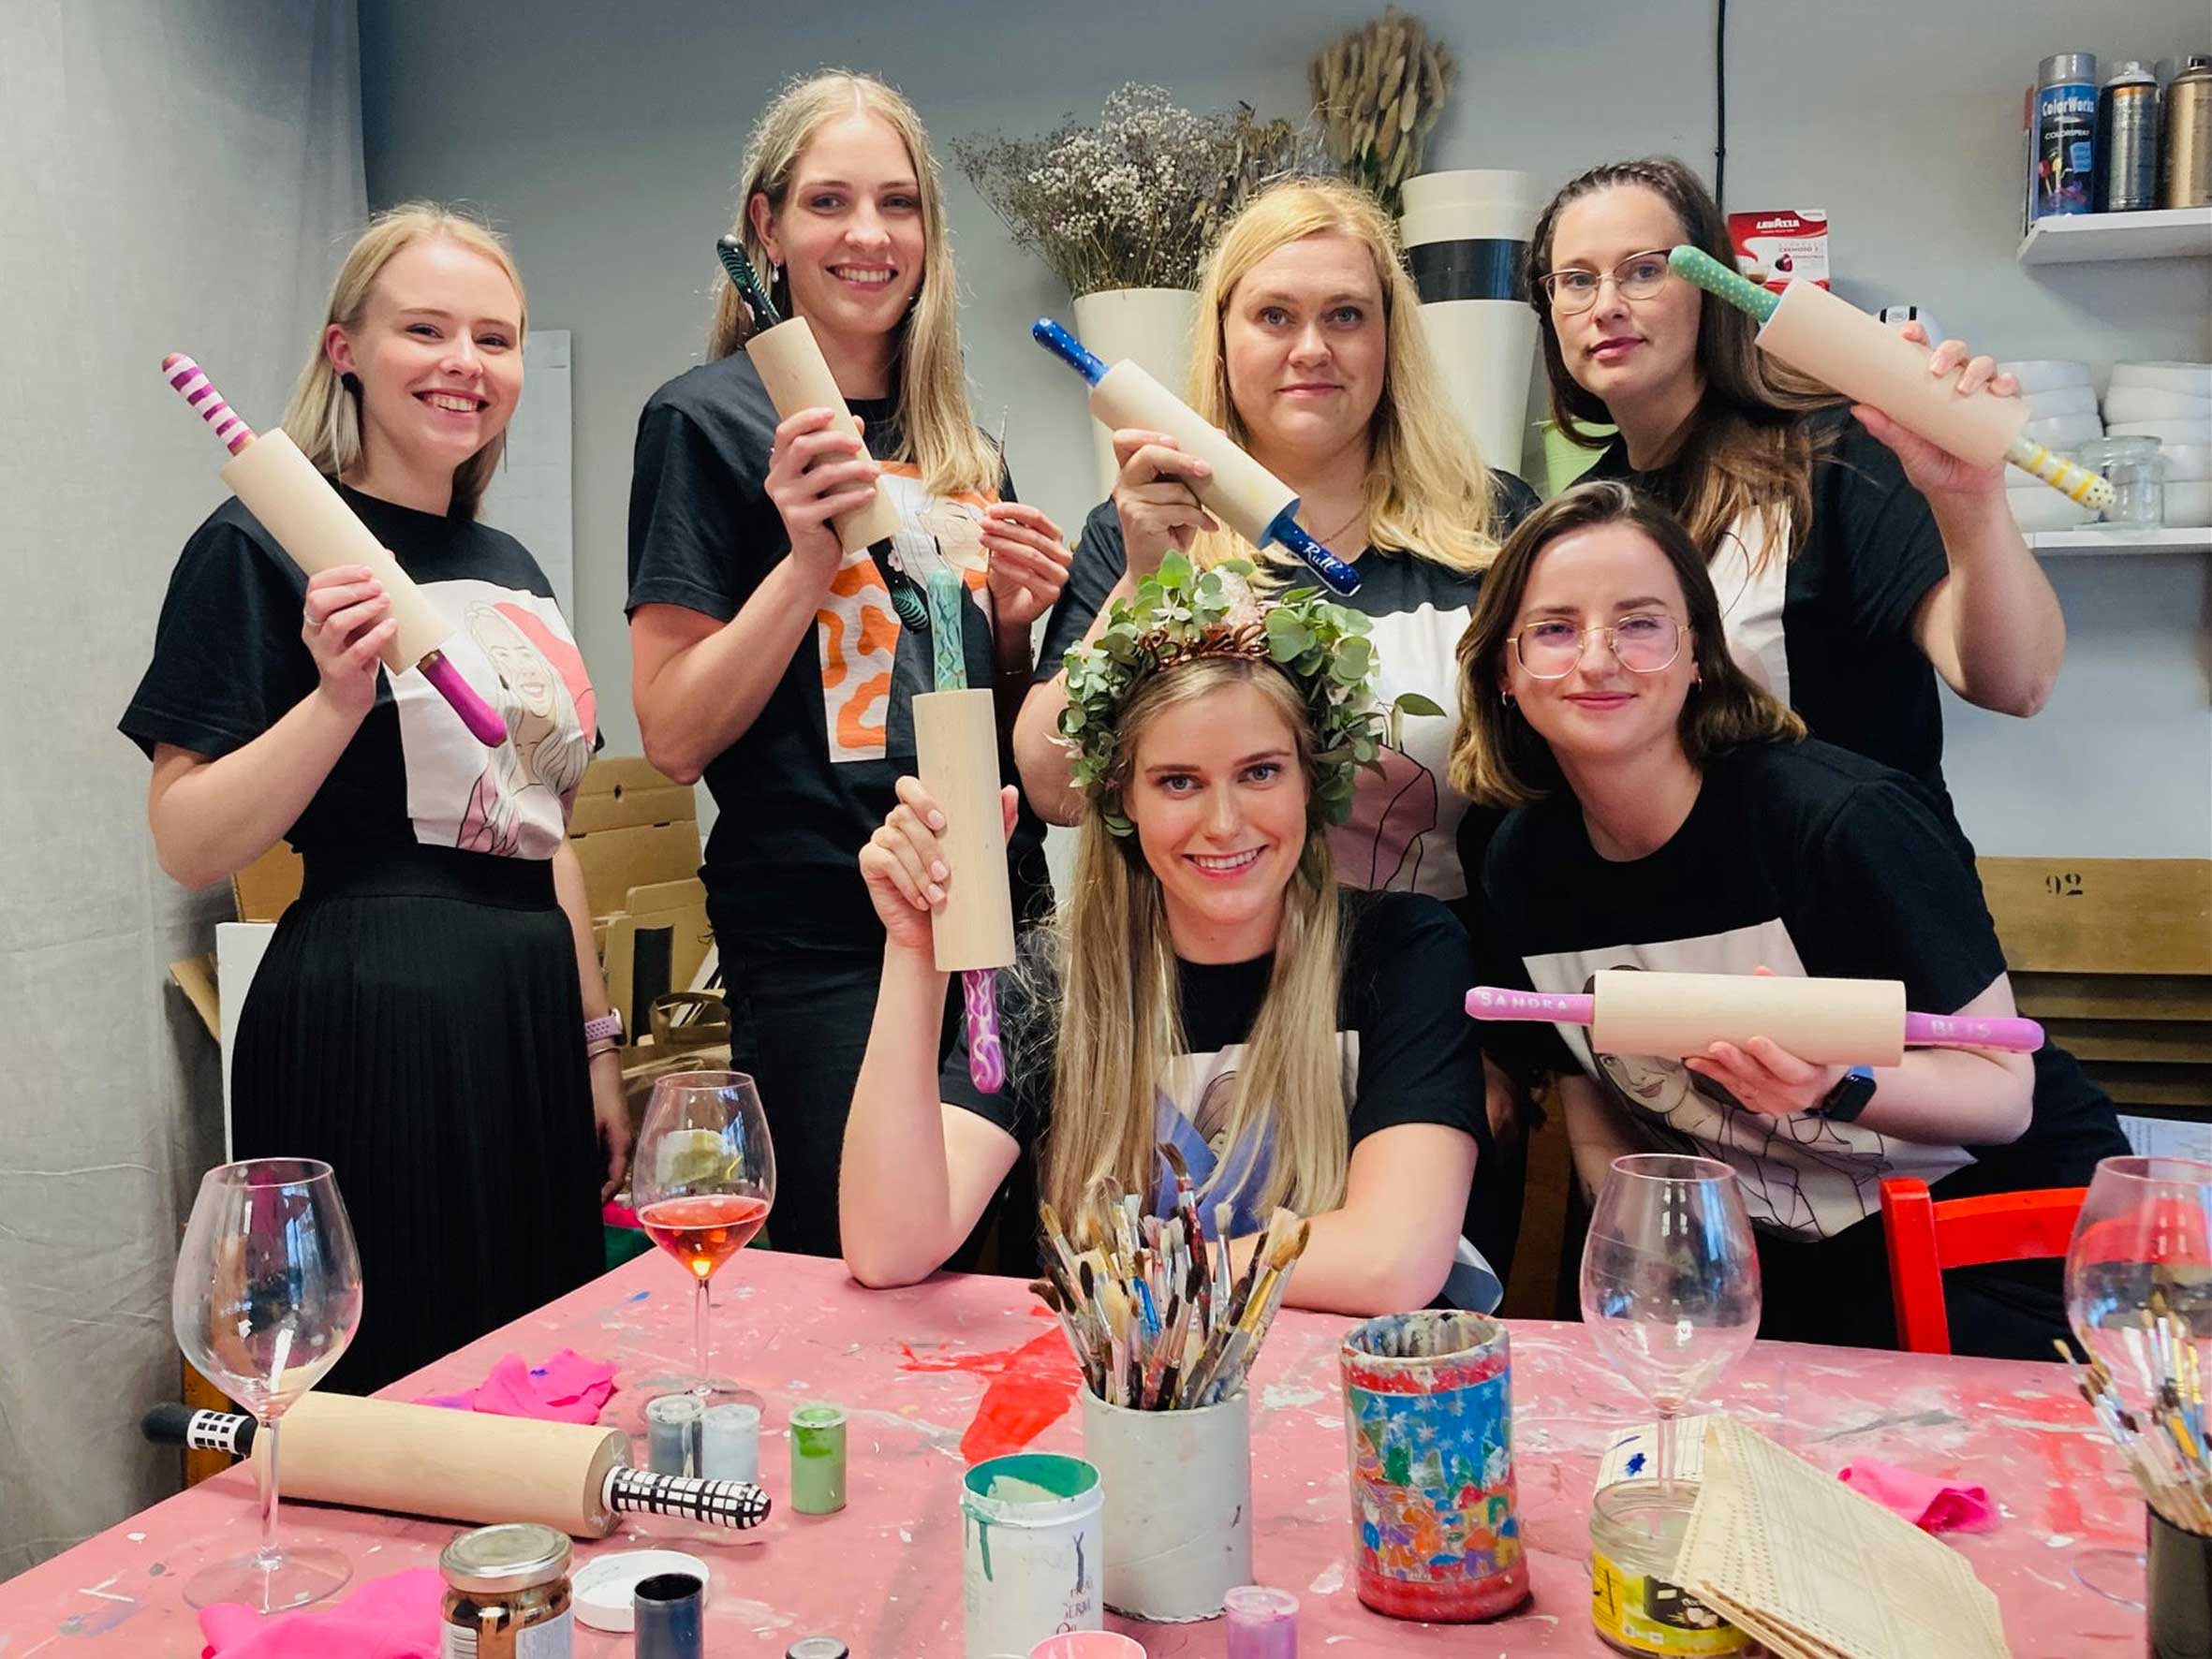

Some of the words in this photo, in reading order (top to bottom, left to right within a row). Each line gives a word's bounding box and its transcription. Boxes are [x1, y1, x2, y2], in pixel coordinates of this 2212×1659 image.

[2042, 96, 2094, 117] ColorWorks
[1756, 217, 1800, 229] LAVAZZA
[2045, 873, 2084, 896] 92
[1480, 991, 1569, 1011] SANDRA
